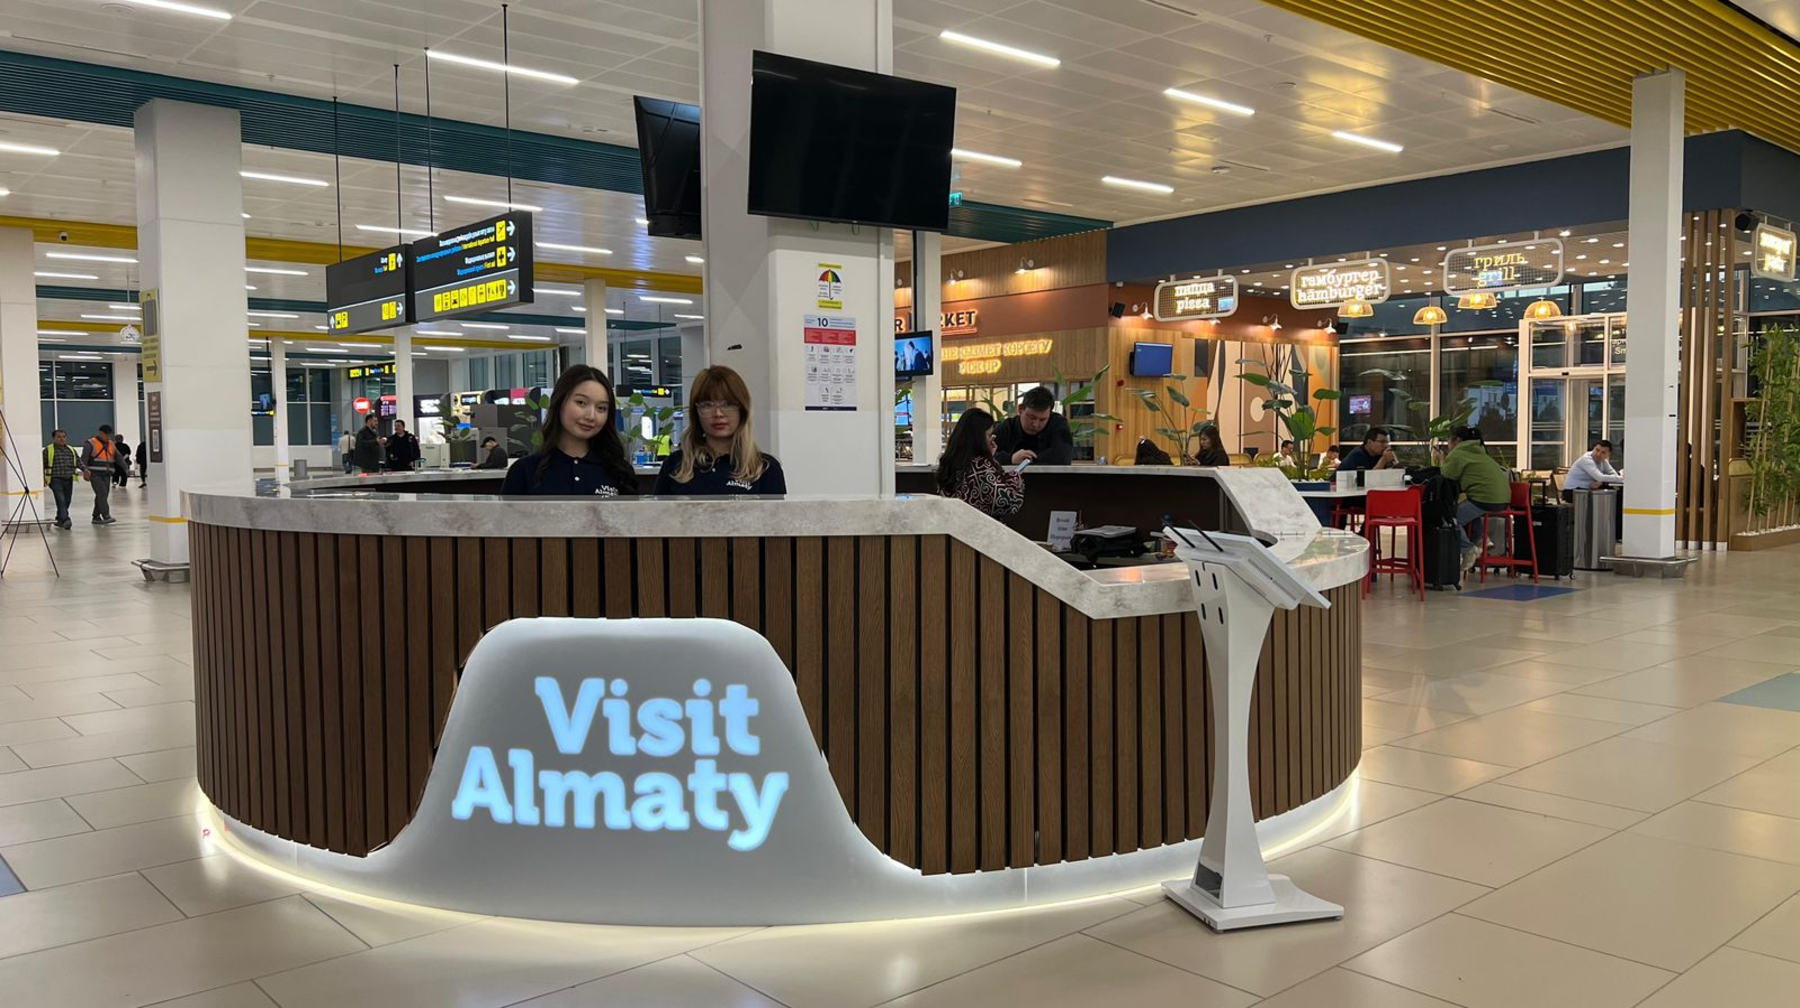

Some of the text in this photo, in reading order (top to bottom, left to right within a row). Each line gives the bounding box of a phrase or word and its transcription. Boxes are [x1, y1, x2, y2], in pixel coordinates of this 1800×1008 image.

[1474, 253, 1525, 271] гриль
[1301, 269, 1384, 288] гамбургер
[1477, 266, 1516, 288] grill
[1174, 282, 1215, 297] пицца
[1296, 283, 1387, 303] hamburger
[1175, 298, 1211, 314] pizza
[534, 676, 761, 757] Visit
[451, 746, 789, 851] Almaty
